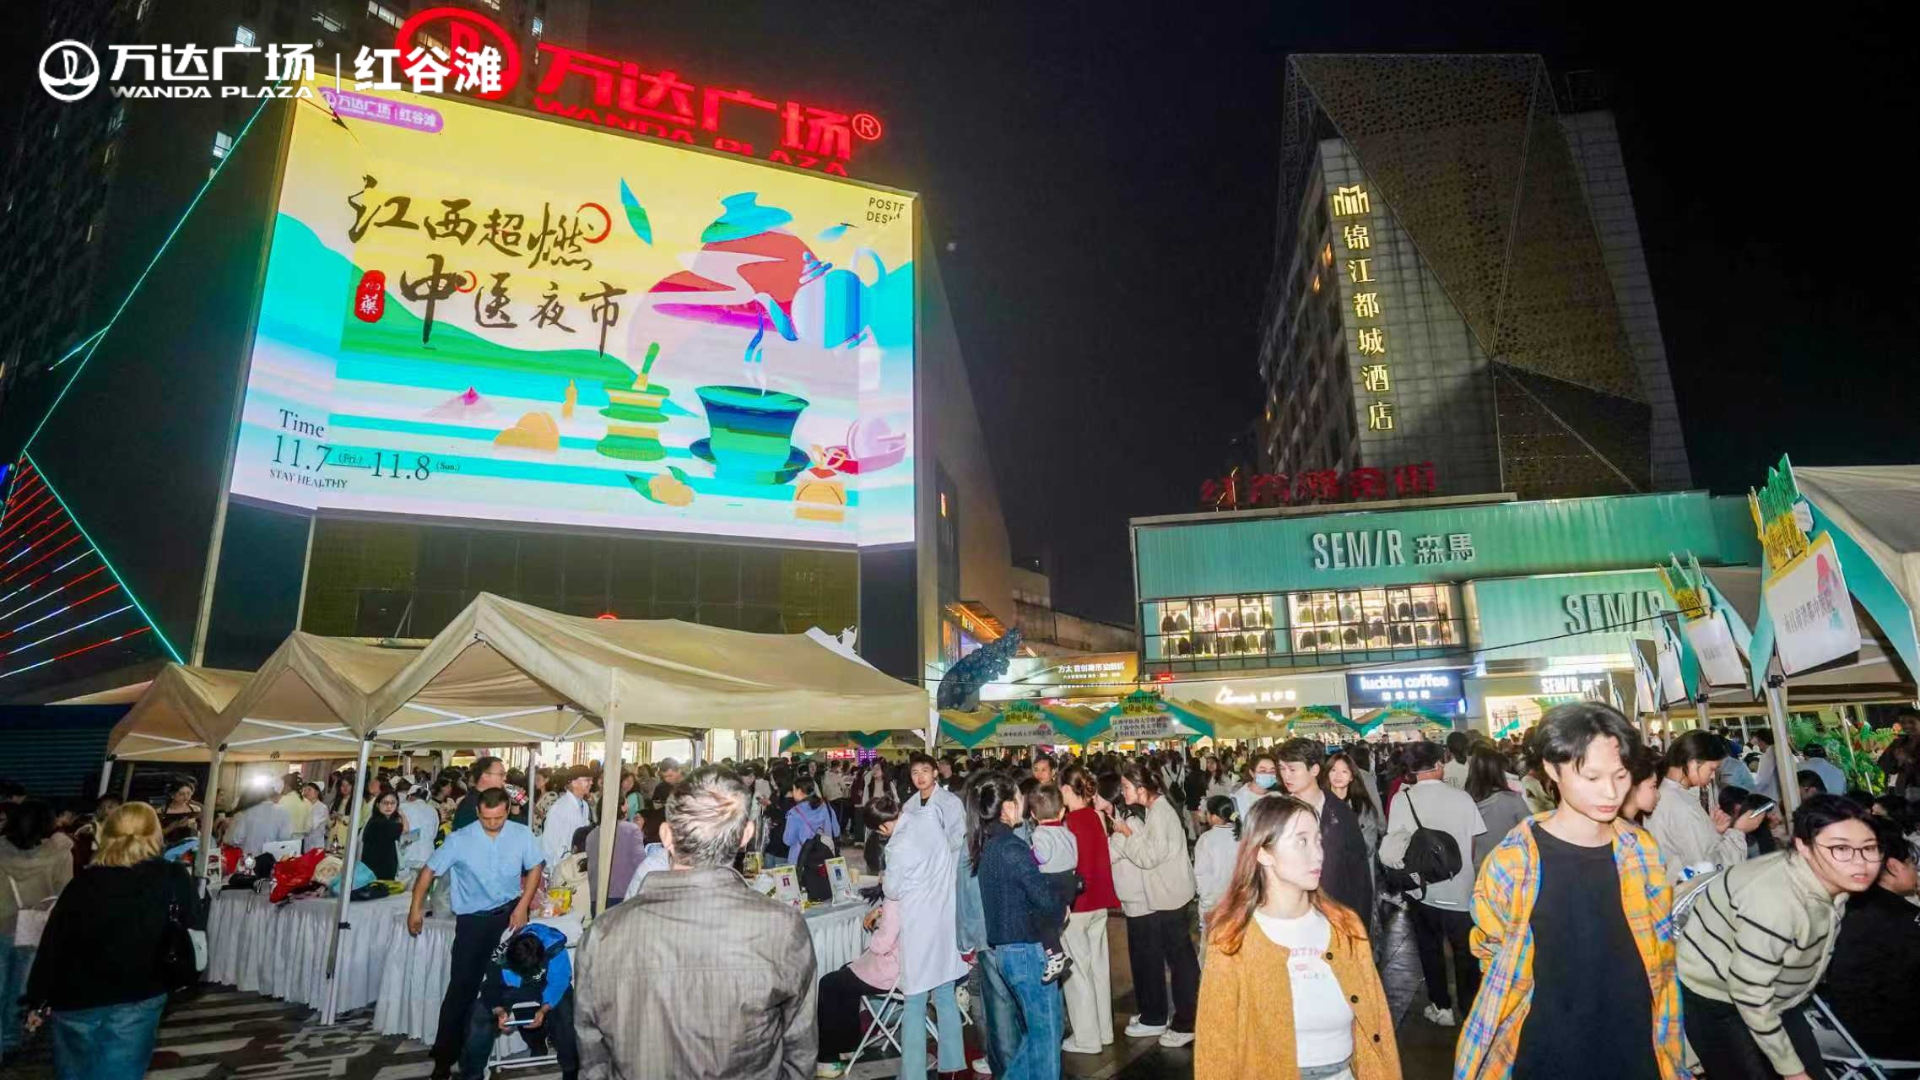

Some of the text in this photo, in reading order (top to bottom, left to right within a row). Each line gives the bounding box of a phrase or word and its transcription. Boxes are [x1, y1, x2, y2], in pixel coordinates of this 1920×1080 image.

[536, 42, 851, 162] 万达广场
[1344, 224, 1394, 430] 锦江都城酒店
[280, 409, 324, 438] Time
[272, 435, 332, 472] 11.7
[371, 451, 431, 481] 11.8
[269, 468, 348, 489] STAY HEALTHY
[1359, 673, 1450, 692] luckin coffee
